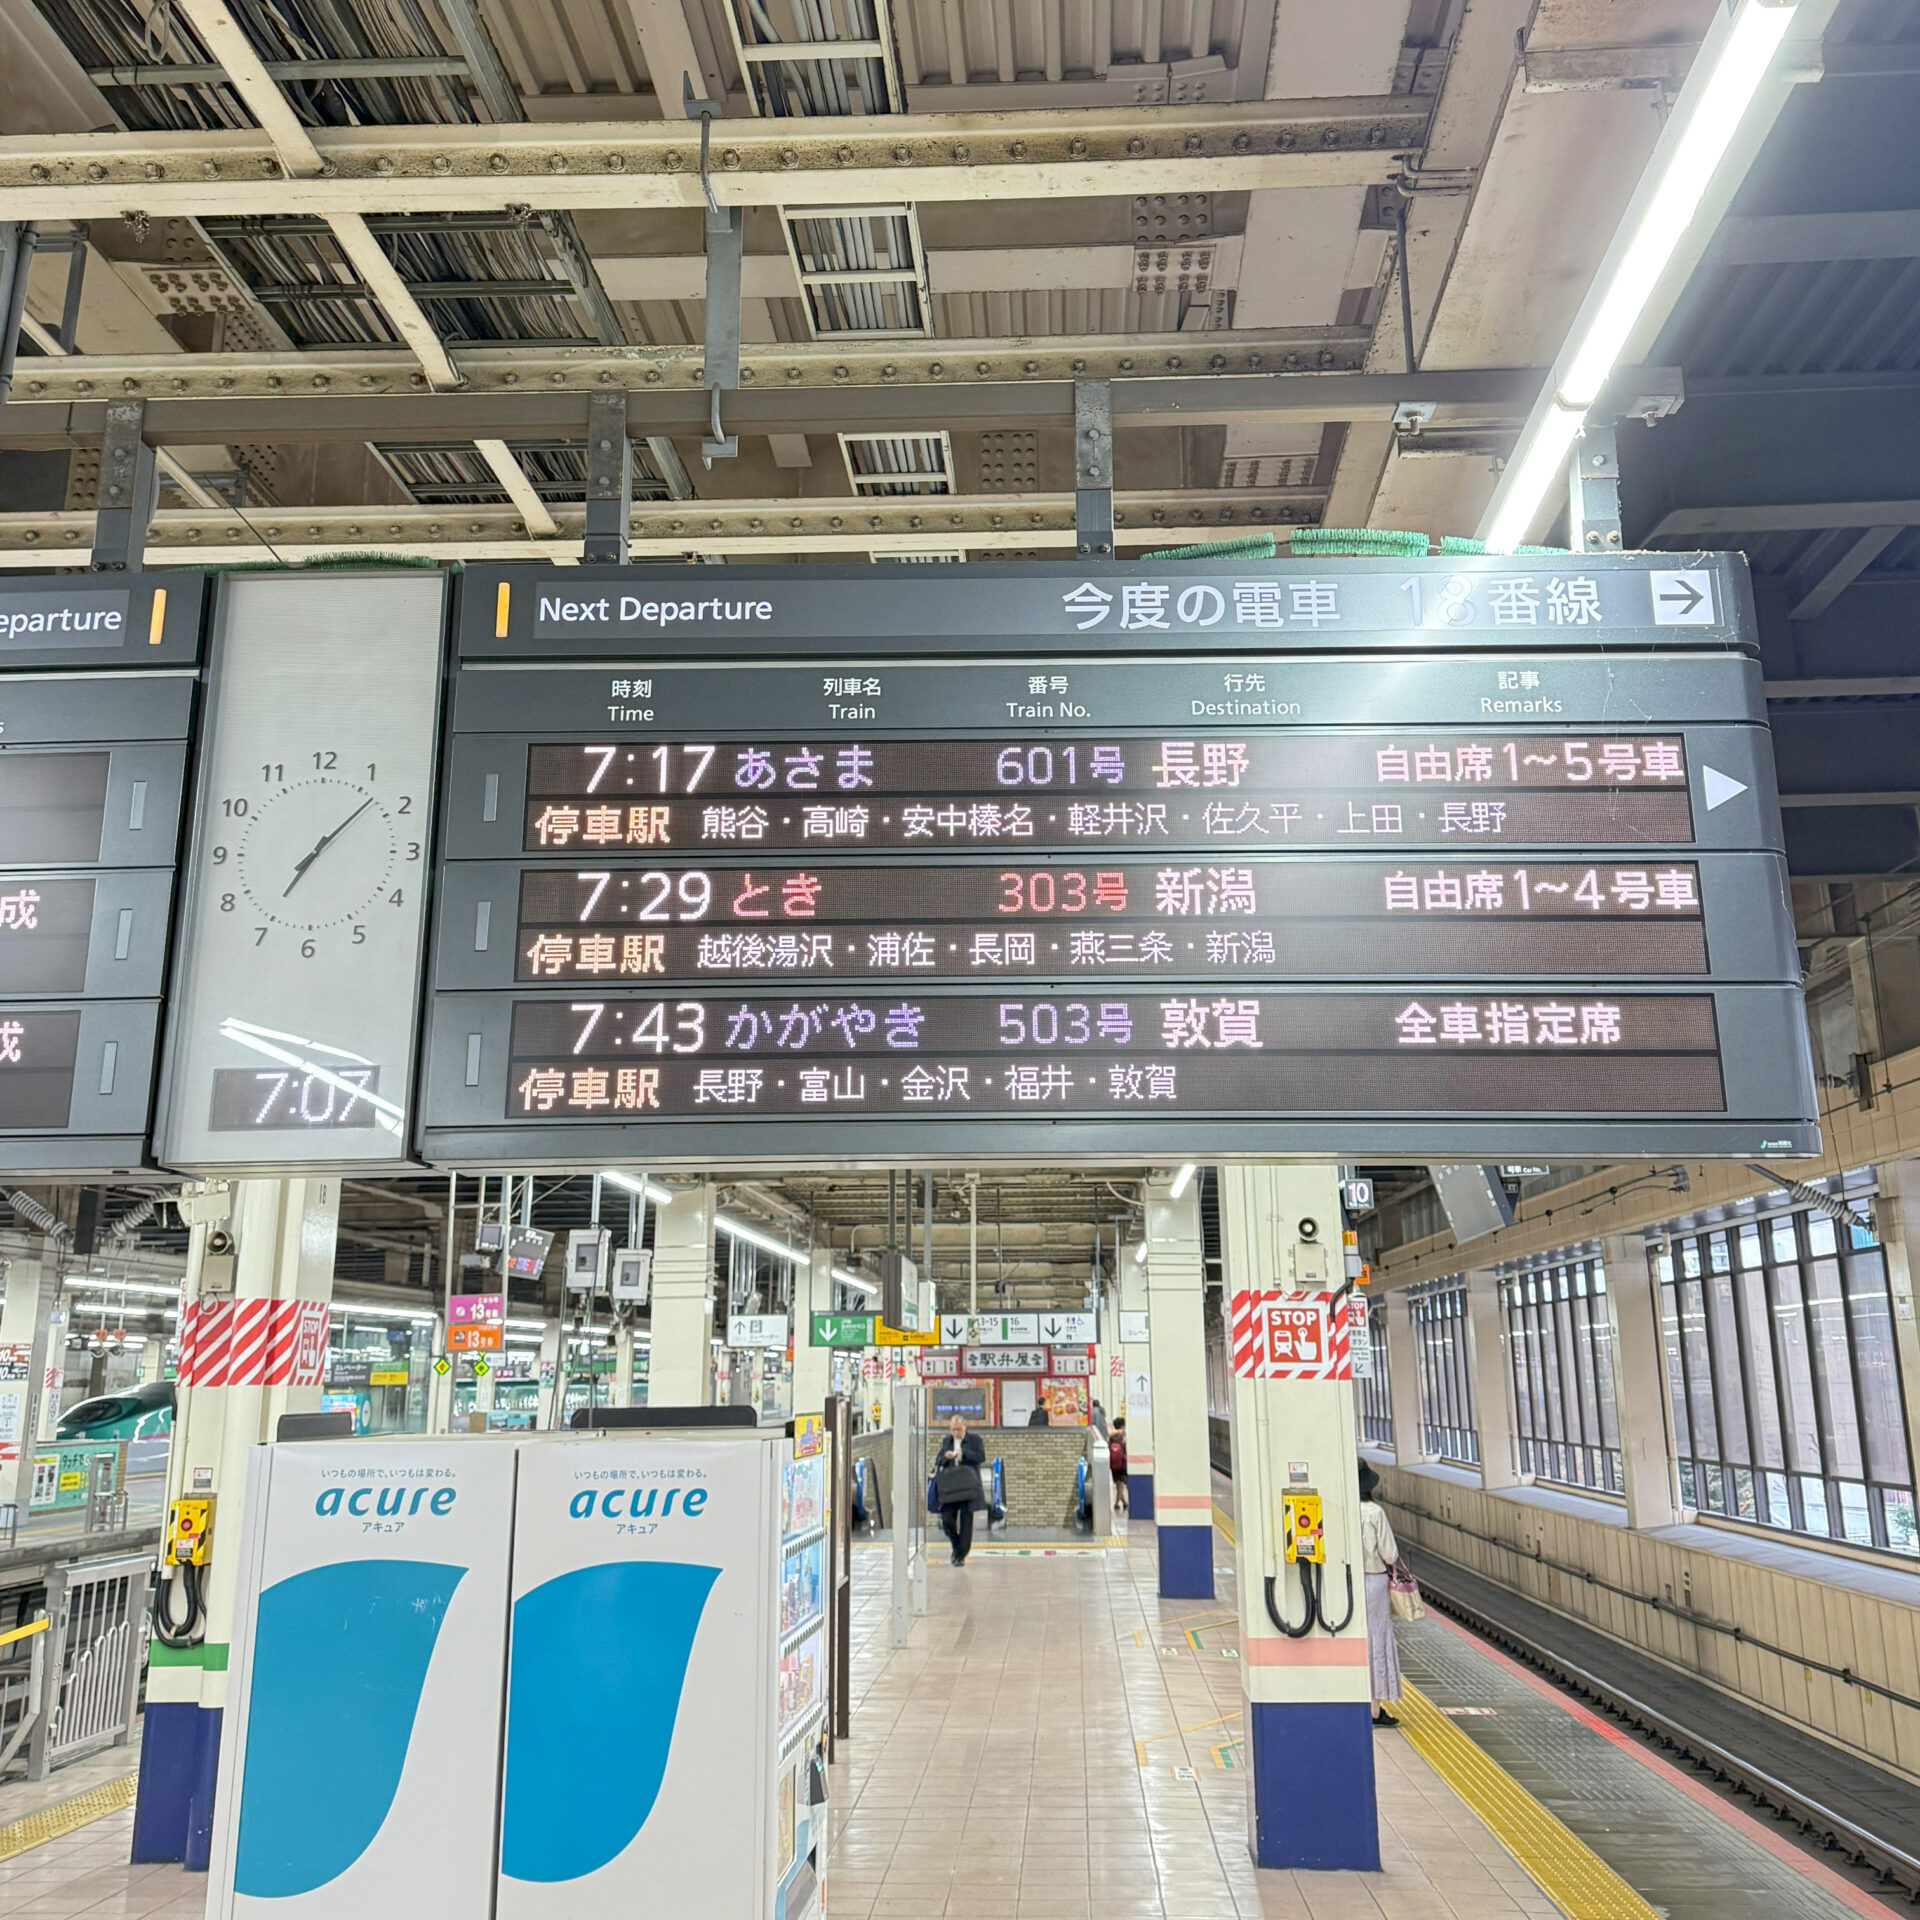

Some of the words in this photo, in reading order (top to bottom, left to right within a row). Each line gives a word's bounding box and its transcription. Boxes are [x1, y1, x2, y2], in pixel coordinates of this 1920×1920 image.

[539, 597, 609, 622] Next
[619, 596, 773, 626] Departure
[1062, 580, 1341, 631] 今度の電車
[1400, 574, 1602, 628] 18番線
[611, 678, 653, 698] 時刻
[823, 677, 882, 696] 列車名
[1028, 676, 1069, 695] 番号
[1223, 673, 1266, 692] 行先
[1498, 671, 1540, 690] 記事
[607, 705, 654, 722] Time
[828, 704, 876, 719] Train
[1005, 703, 1051, 719] Train
[1055, 702, 1092, 718] No.
[1191, 699, 1301, 716] Destination
[1480, 696, 1563, 714] Remarks
[312, 751, 337, 770] 12
[583, 745, 716, 793] 7:17
[735, 745, 875, 789] あさま
[997, 745, 1124, 786] 601号
[1152, 742, 1249, 789] 長野
[262, 765, 285, 782] 11
[367, 764, 377, 780] 1
[222, 798, 248, 817] 10
[397, 796, 411, 814] 2
[534, 806, 670, 845] 停車駅
[213, 846, 227, 865] 9
[407, 842, 420, 861] 3
[220, 893, 235, 912] 8
[389, 889, 403, 907] 4
[577, 873, 711, 921] 7:29
[733, 873, 822, 918] とき
[998, 871, 1128, 913] 303号
[1156, 868, 1256, 916] 新潟
[254, 928, 268, 946] 7
[352, 926, 366, 944] 5
[301, 940, 315, 958] 6
[526, 935, 665, 975] 停車駅
[570, 1003, 705, 1054] 7:43
[725, 1004, 925, 1049] かがやき
[1000, 1002, 1132, 1045] 503号
[1161, 999, 1263, 1049] 敦賀
[1395, 1001, 1622, 1045] 全車指定席
[256, 1072, 372, 1123] 7:07
[519, 1068, 659, 1110] 停車駅
[1348, 1182, 1369, 1203] 10
[303, 1320, 319, 1333] STOP
[1010, 1317, 1020, 1326] 16
[1271, 1310, 1317, 1326] STOP
[315, 1487, 457, 1516] acure
[569, 1488, 708, 1518] acure
[362, 1521, 405, 1533] アキュア
[616, 1523, 658, 1535] アキュア
